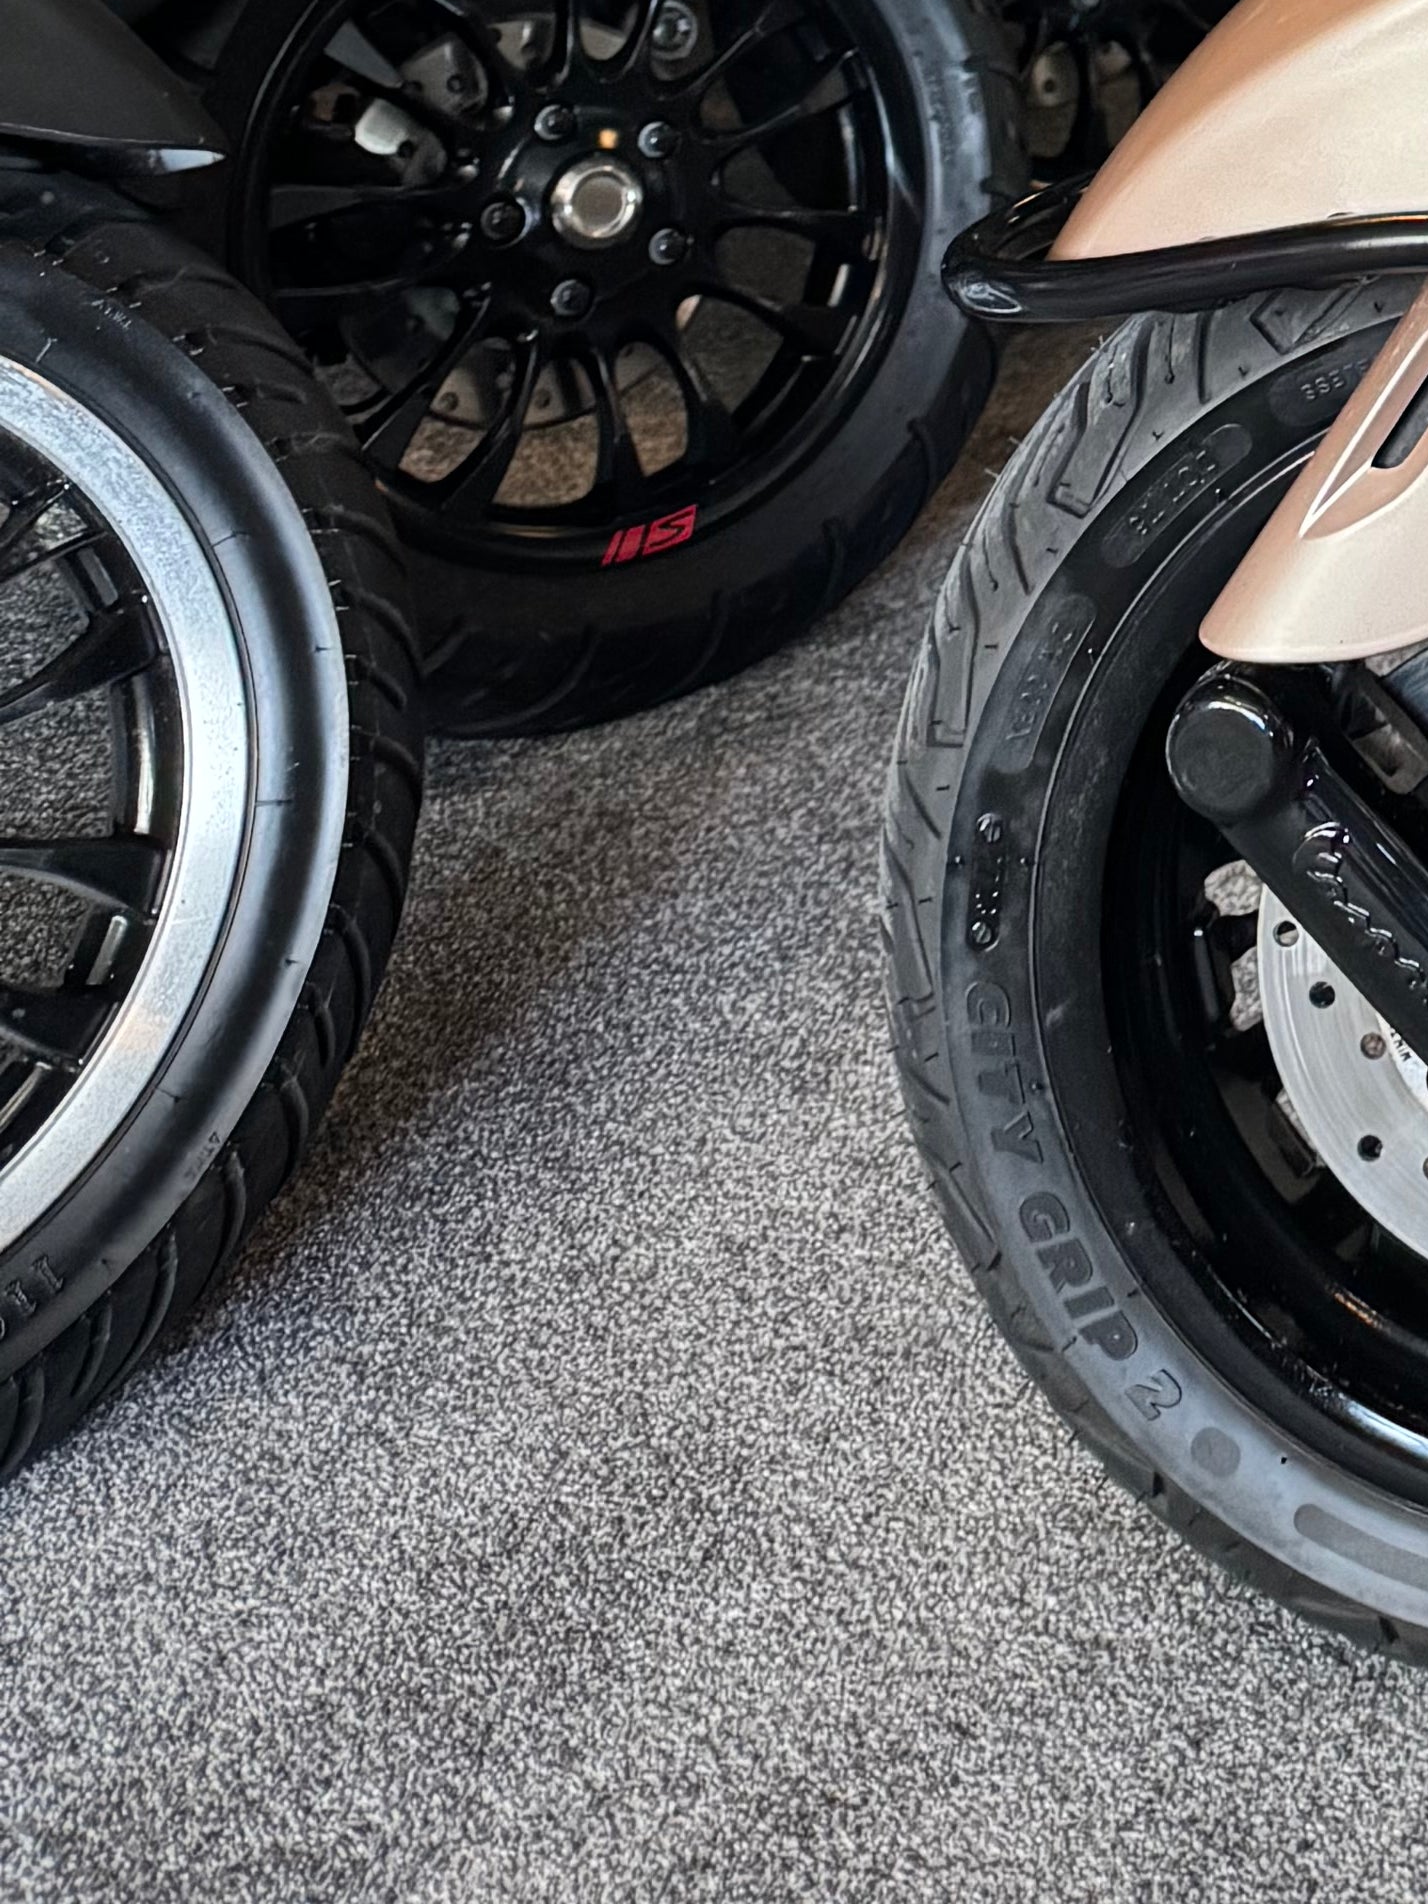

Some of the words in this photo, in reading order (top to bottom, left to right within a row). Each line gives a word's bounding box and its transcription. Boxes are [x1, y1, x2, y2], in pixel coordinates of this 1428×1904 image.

[963, 979, 1045, 1166] CITY
[1018, 1191, 1139, 1361] GRIP
[1124, 1368, 1183, 1422] 2
